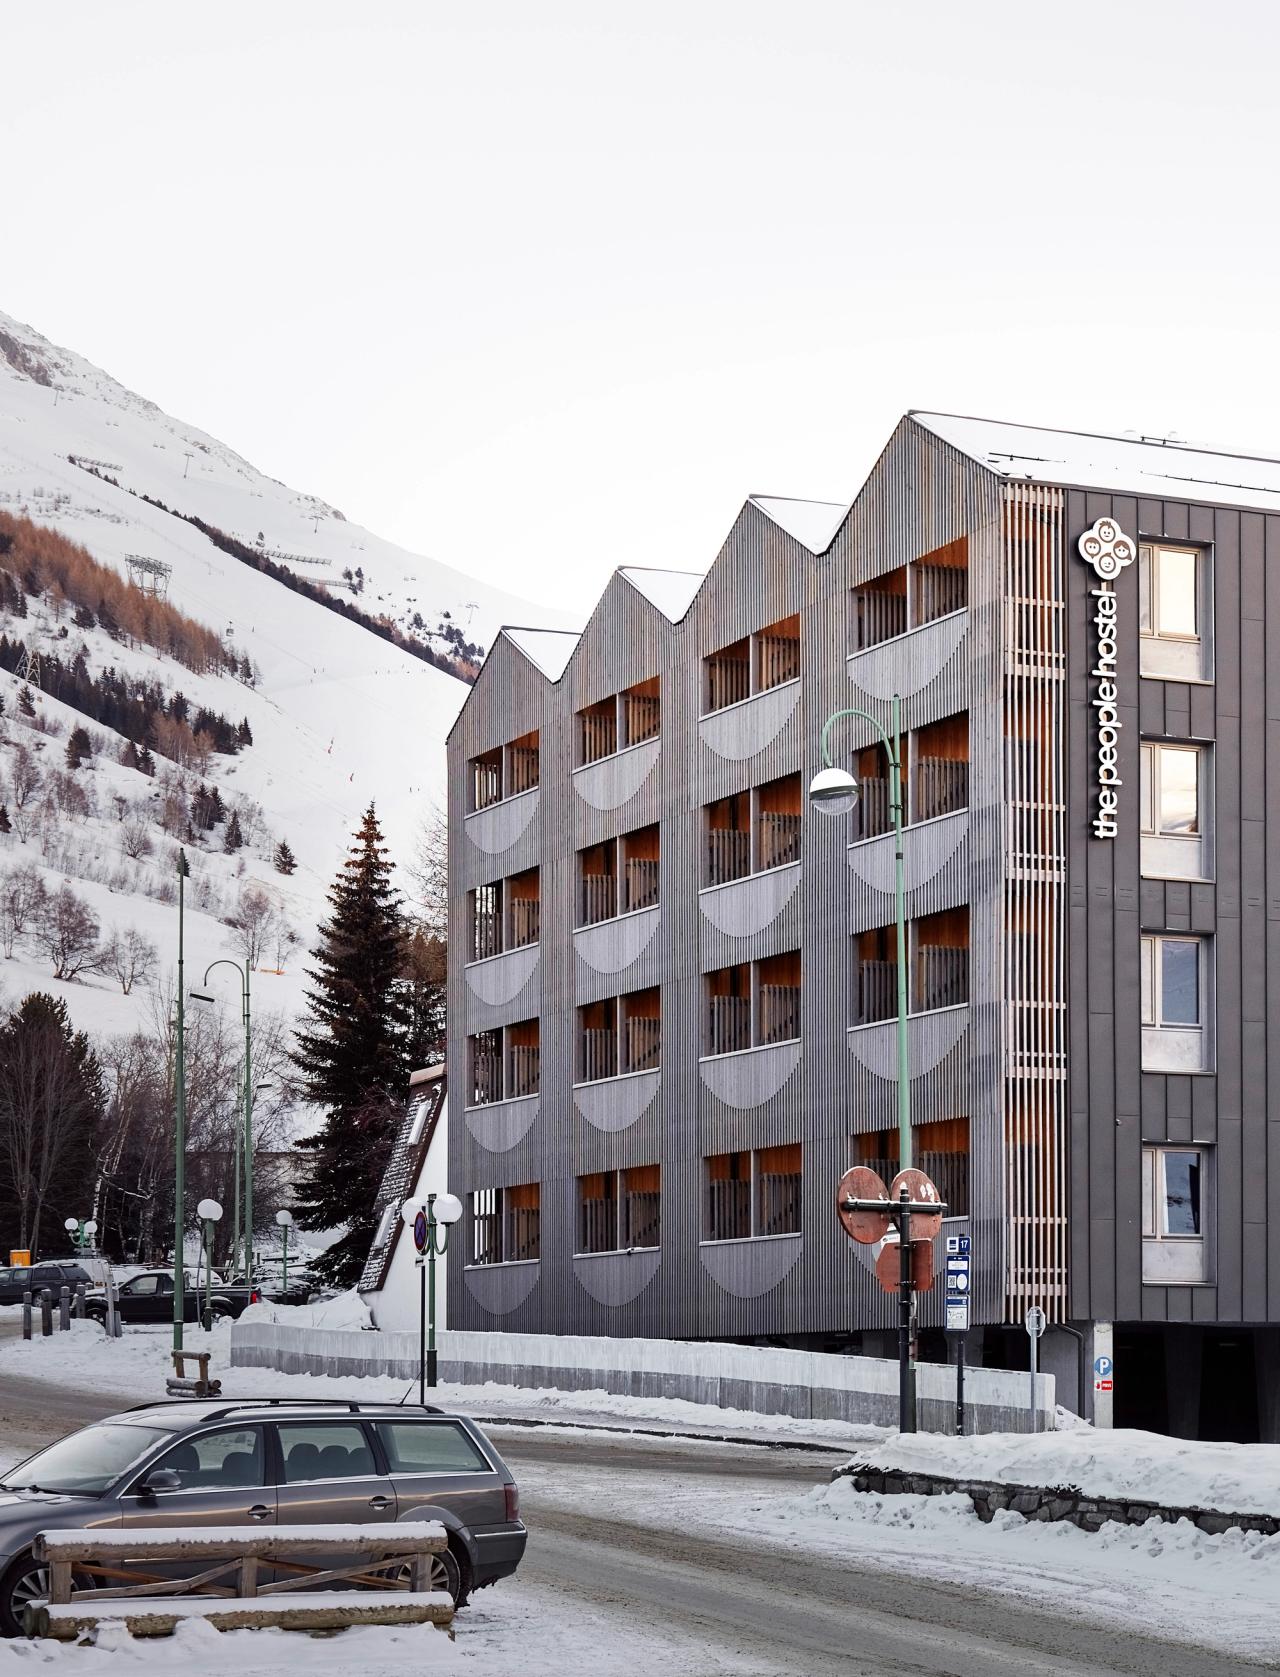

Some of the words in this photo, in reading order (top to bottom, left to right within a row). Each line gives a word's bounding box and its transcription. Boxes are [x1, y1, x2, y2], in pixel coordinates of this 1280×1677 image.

[1091, 589, 1117, 677] hostel
[1092, 683, 1122, 785] people
[1093, 791, 1117, 839] the
[960, 1240, 969, 1249] 17
[1100, 1359, 1109, 1374] P
